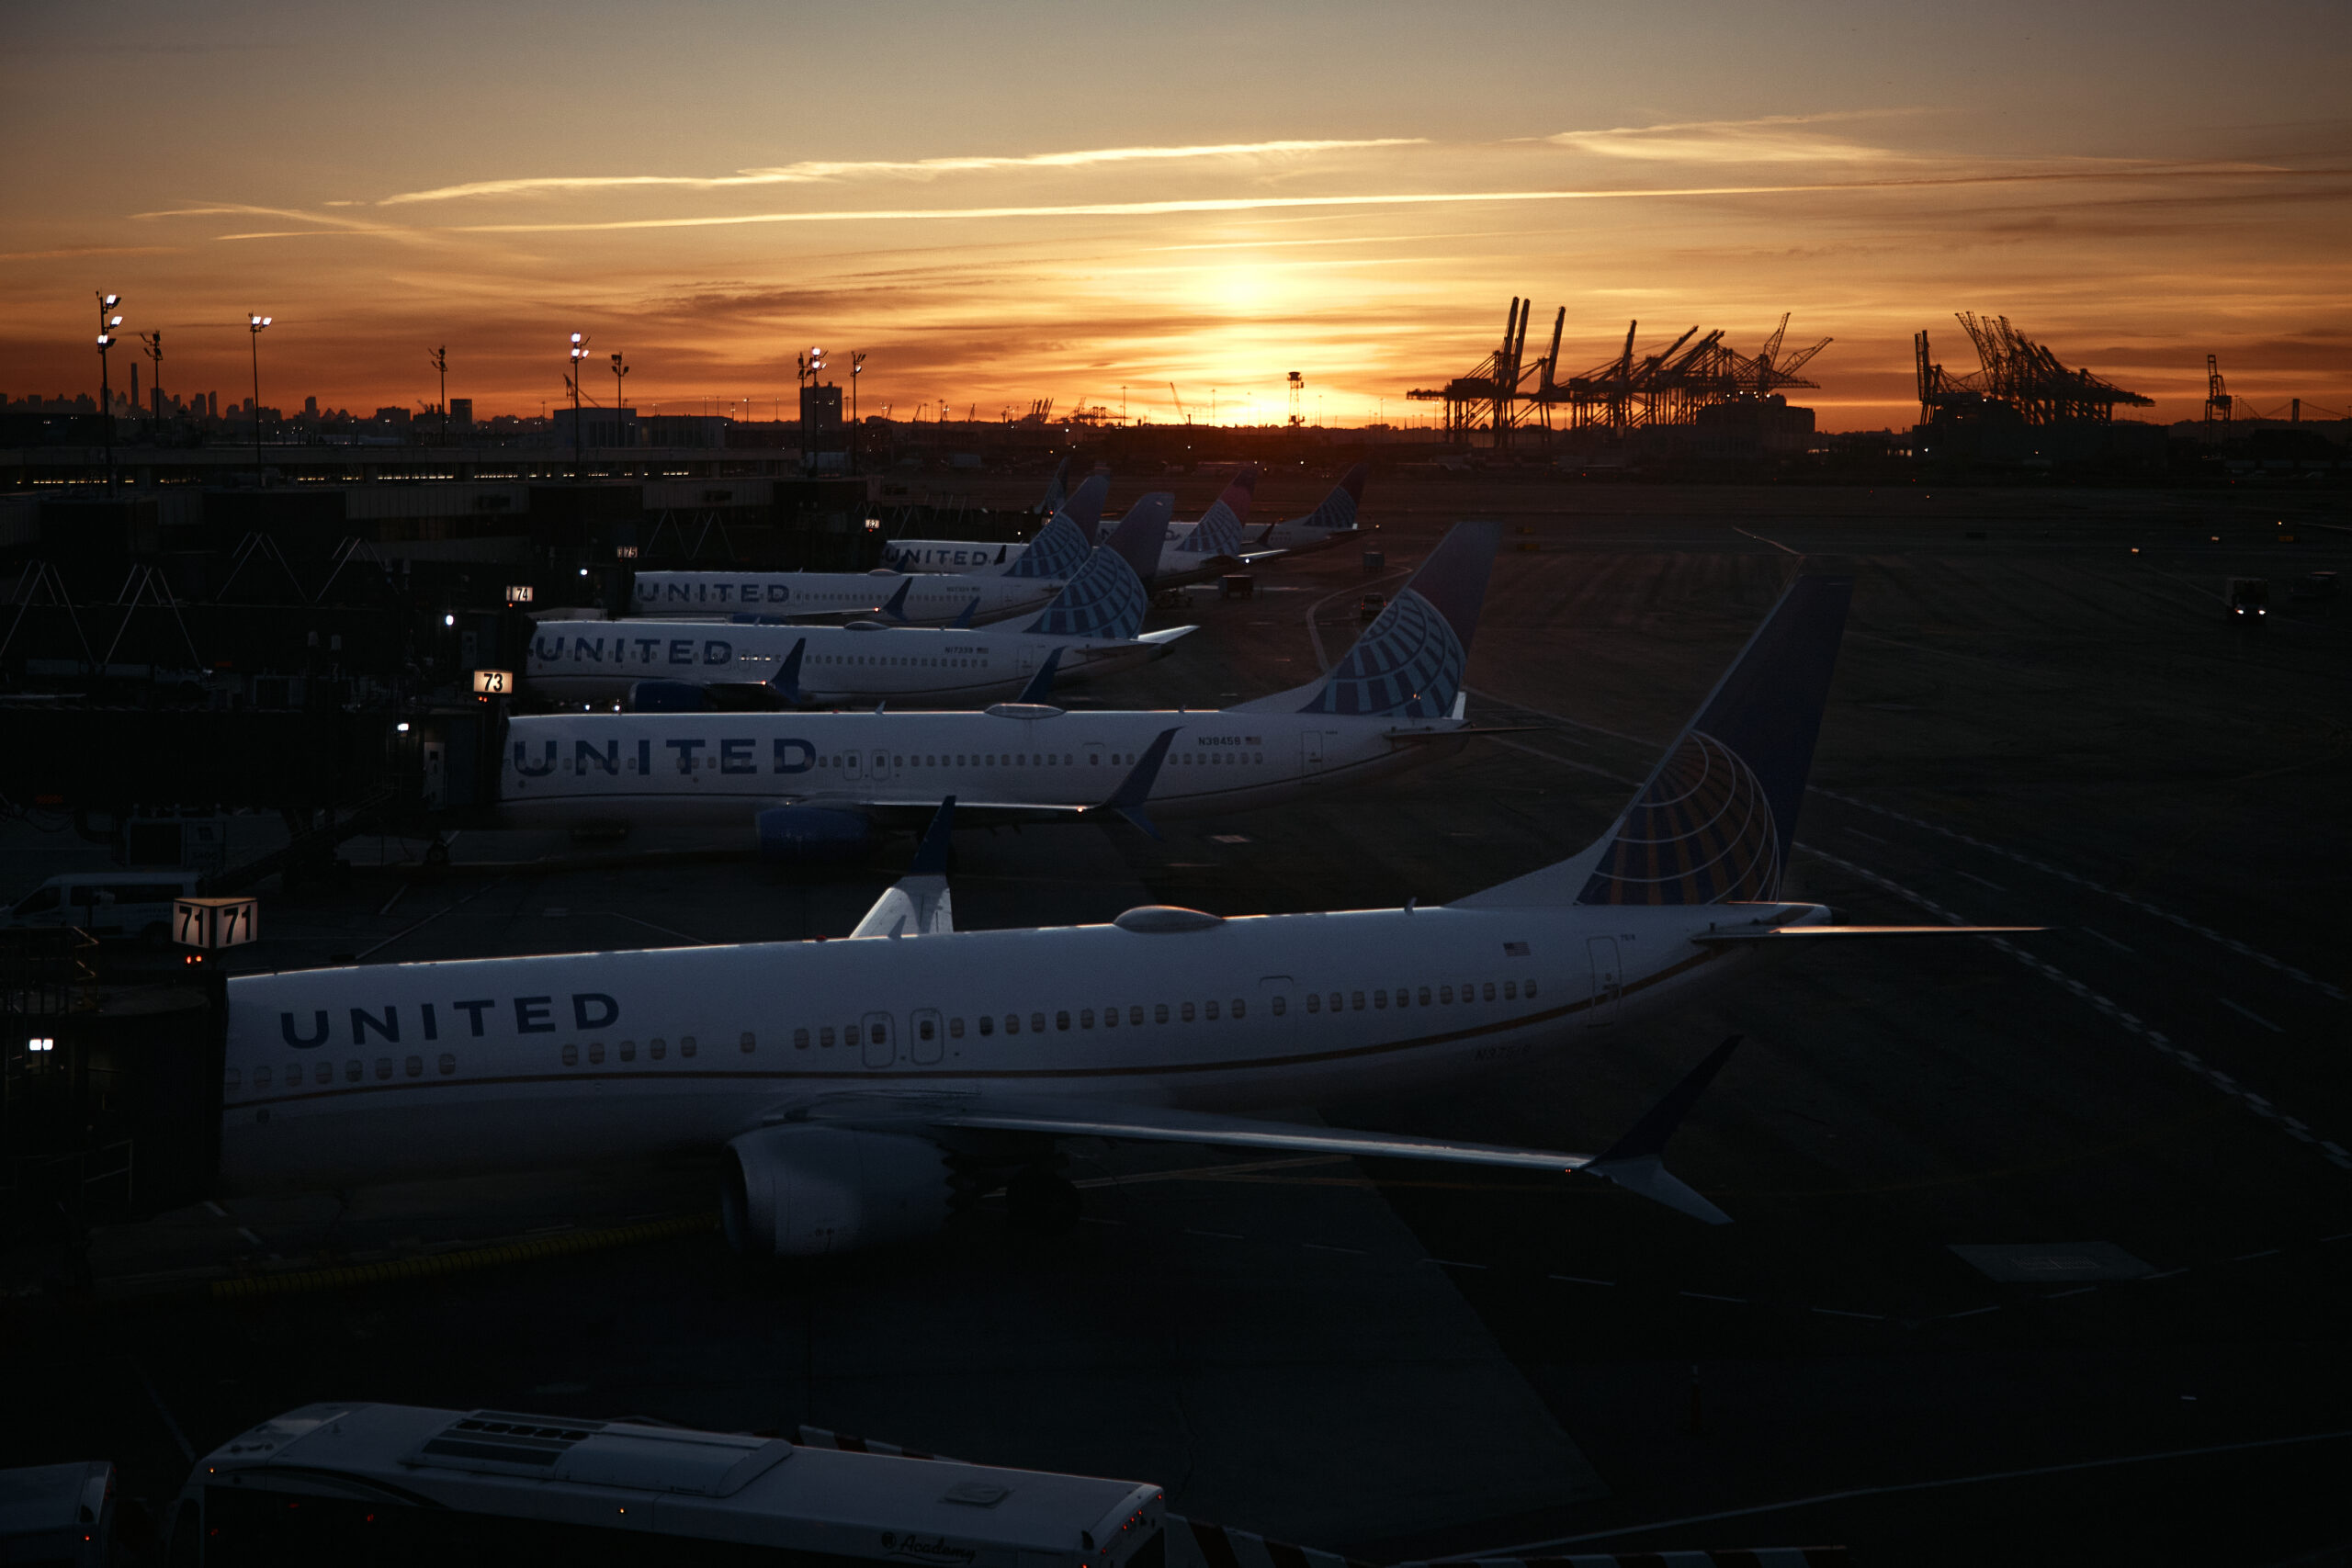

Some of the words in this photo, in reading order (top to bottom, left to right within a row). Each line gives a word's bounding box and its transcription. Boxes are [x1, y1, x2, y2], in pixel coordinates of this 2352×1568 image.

[626, 547, 636, 557] 75
[885, 548, 989, 566] UNITED
[516, 589, 528, 603] 74
[638, 582, 790, 604] UNITED
[536, 637, 732, 665] UNITED
[483, 674, 503, 693] 73
[514, 739, 817, 777] UNITED
[178, 906, 204, 945] 71
[223, 906, 252, 944] 71
[281, 992, 620, 1049] UNITED
[899, 1534, 977, 1565] Academy
